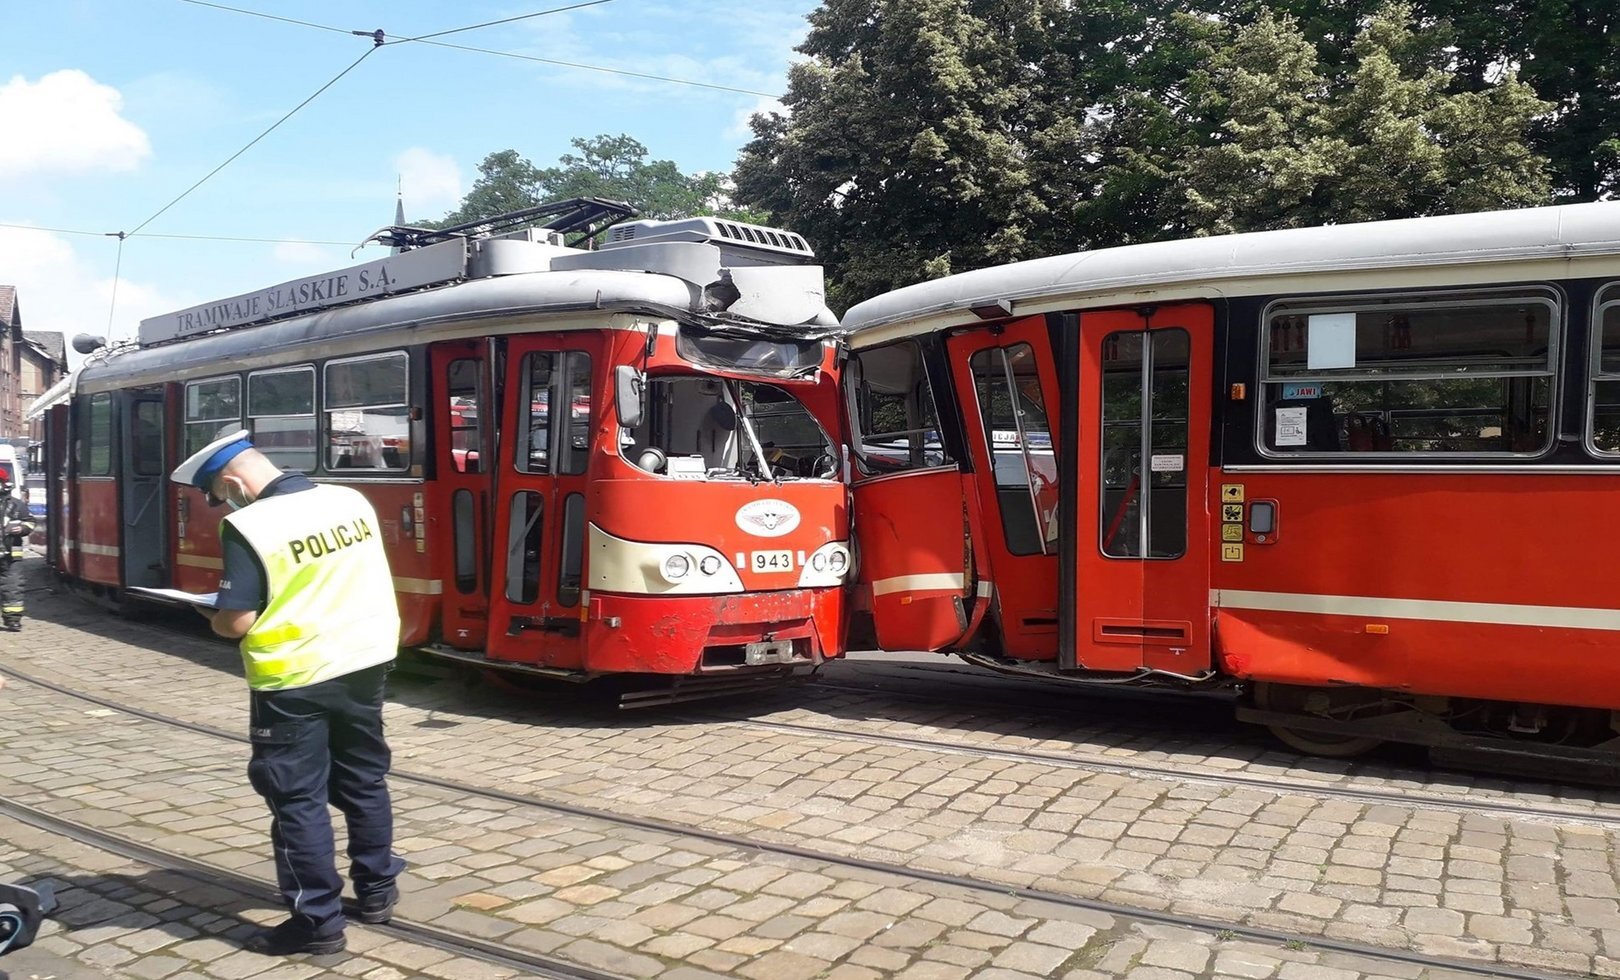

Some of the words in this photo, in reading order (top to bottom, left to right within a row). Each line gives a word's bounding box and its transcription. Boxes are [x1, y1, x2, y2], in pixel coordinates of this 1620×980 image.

[177, 296, 261, 332] TRAMWAJE
[358, 265, 397, 292] S.A.
[288, 517, 373, 564] POLICJA
[756, 553, 790, 569] 943
